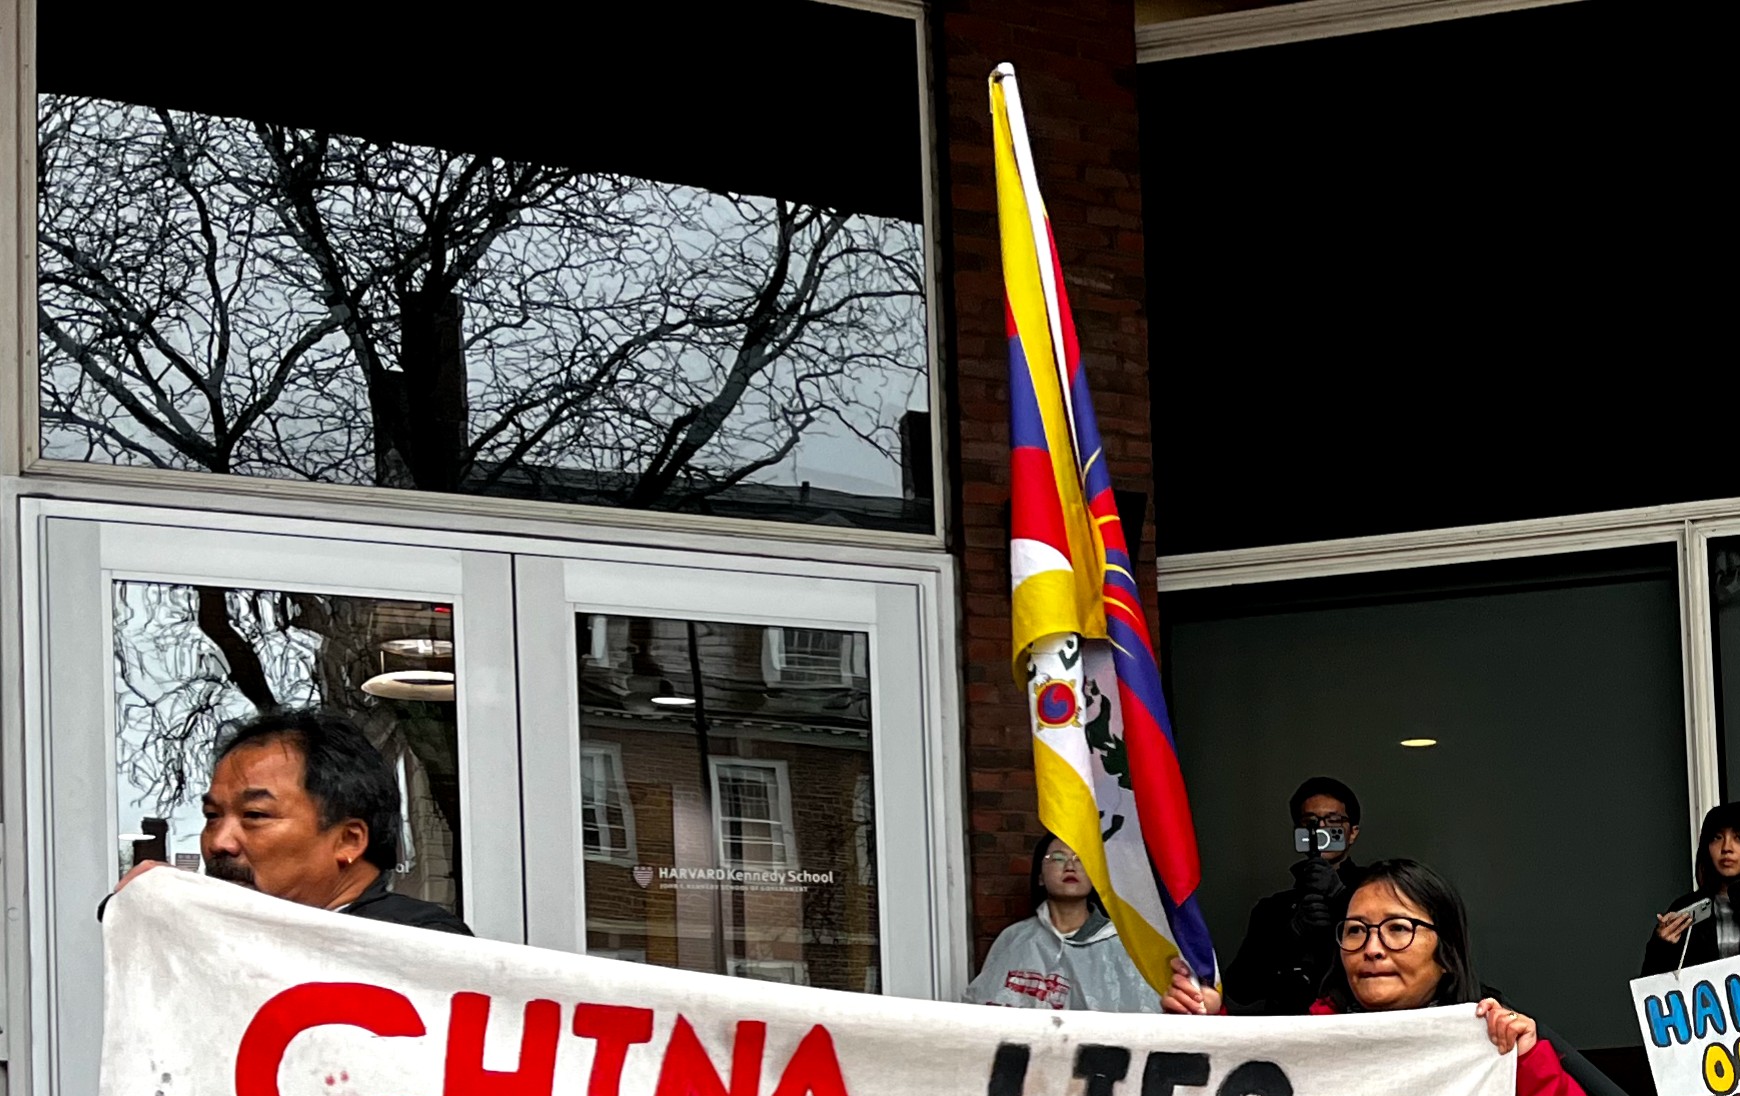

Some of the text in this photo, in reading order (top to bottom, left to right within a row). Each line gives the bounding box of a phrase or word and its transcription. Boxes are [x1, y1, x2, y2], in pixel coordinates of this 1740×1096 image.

[659, 868, 833, 884] HARVARD Kennedy School
